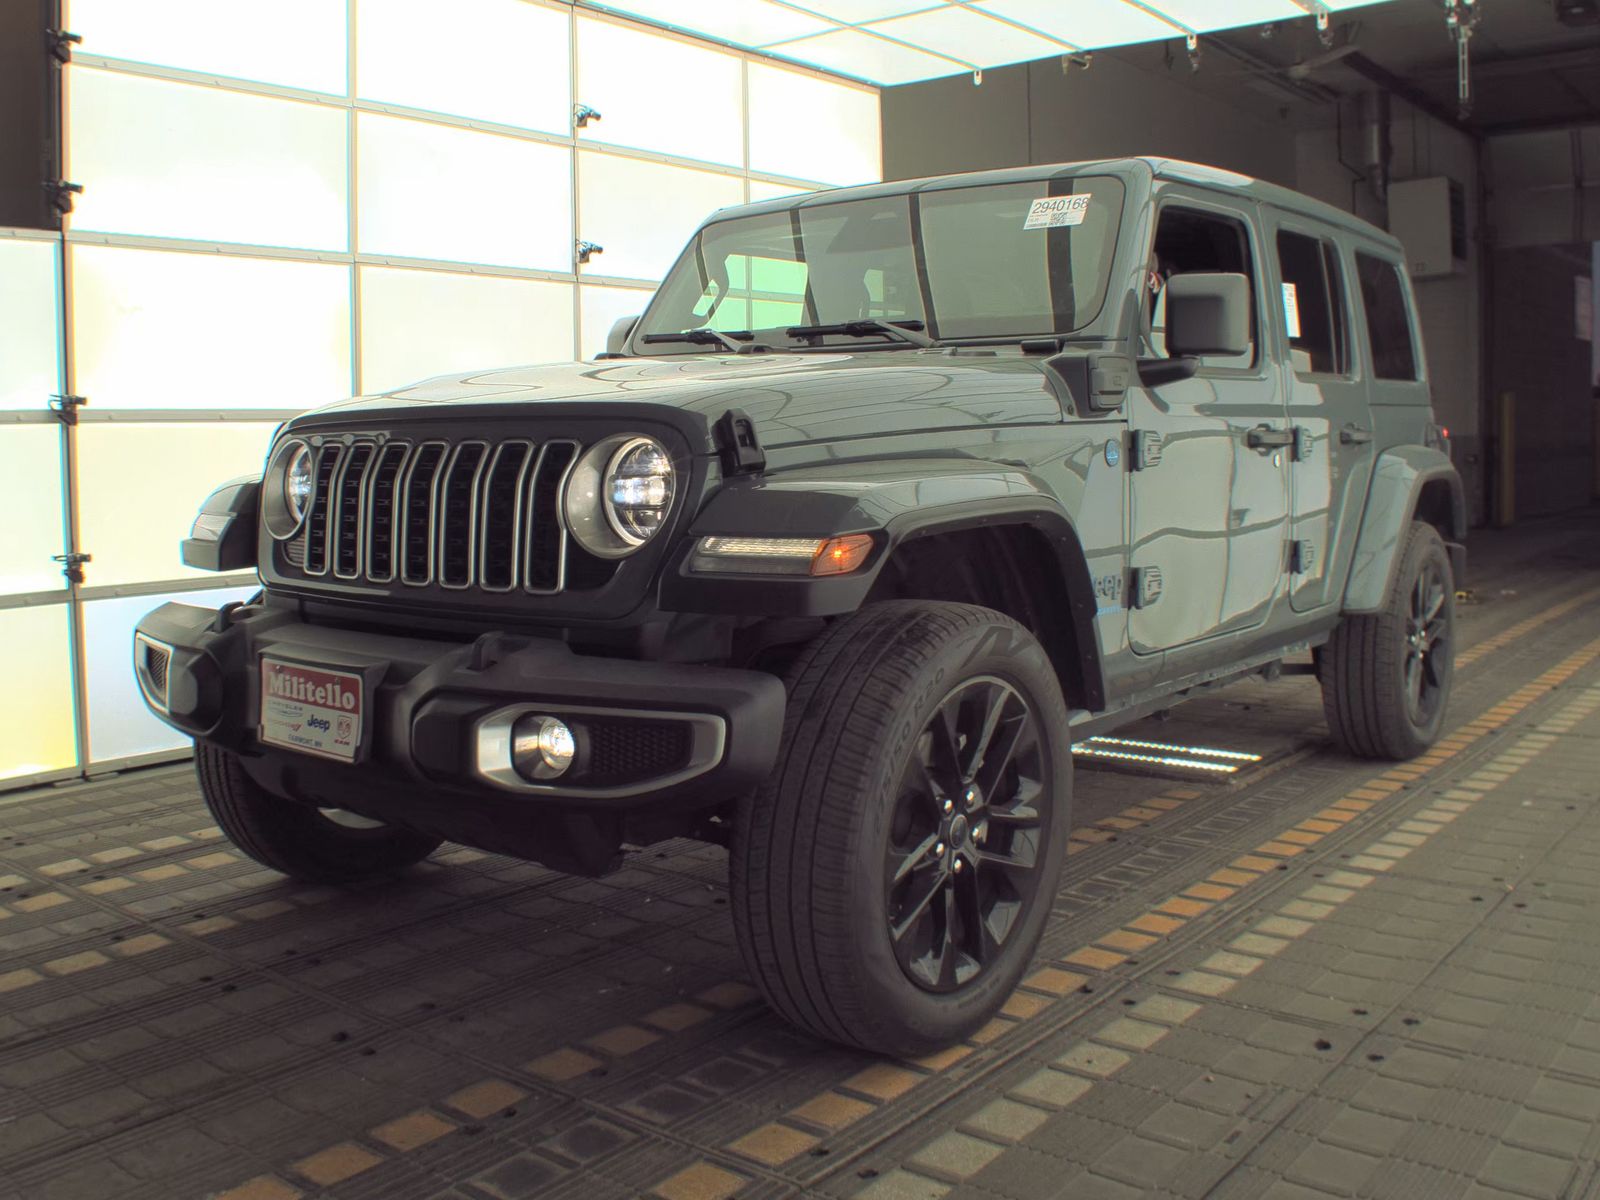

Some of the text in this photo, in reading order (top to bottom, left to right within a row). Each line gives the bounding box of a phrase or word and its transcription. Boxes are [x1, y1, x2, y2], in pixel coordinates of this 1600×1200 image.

[1032, 197, 1089, 214] 2940168
[269, 671, 355, 710] Militello
[307, 714, 330, 732] Jeep
